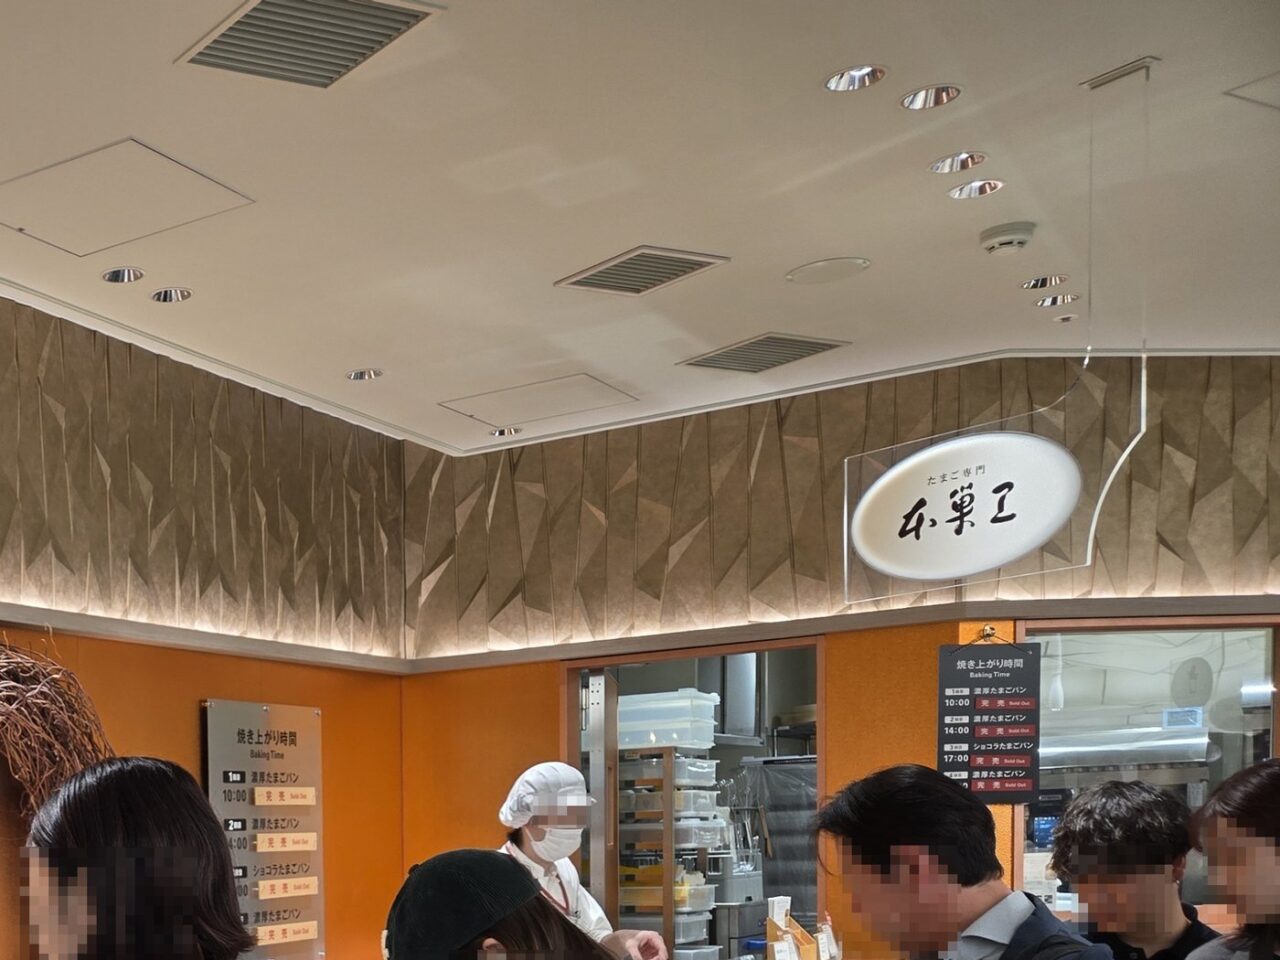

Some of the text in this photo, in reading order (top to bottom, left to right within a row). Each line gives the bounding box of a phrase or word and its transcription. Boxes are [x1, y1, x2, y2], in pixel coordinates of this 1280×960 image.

[928, 464, 986, 486] たまご専門
[956, 658, 1024, 670] 焼き上がり時間
[945, 698, 970, 706] 10:00
[944, 726, 970, 734] 14:00
[237, 728, 296, 747] 焼き上がり時間
[974, 742, 1034, 750] ショコラたまごパン
[250, 750, 284, 760] Baking Time
[944, 754, 968, 762] 17:00
[223, 789, 247, 802] 10:00
[253, 863, 310, 877] ショコラたまごパン
